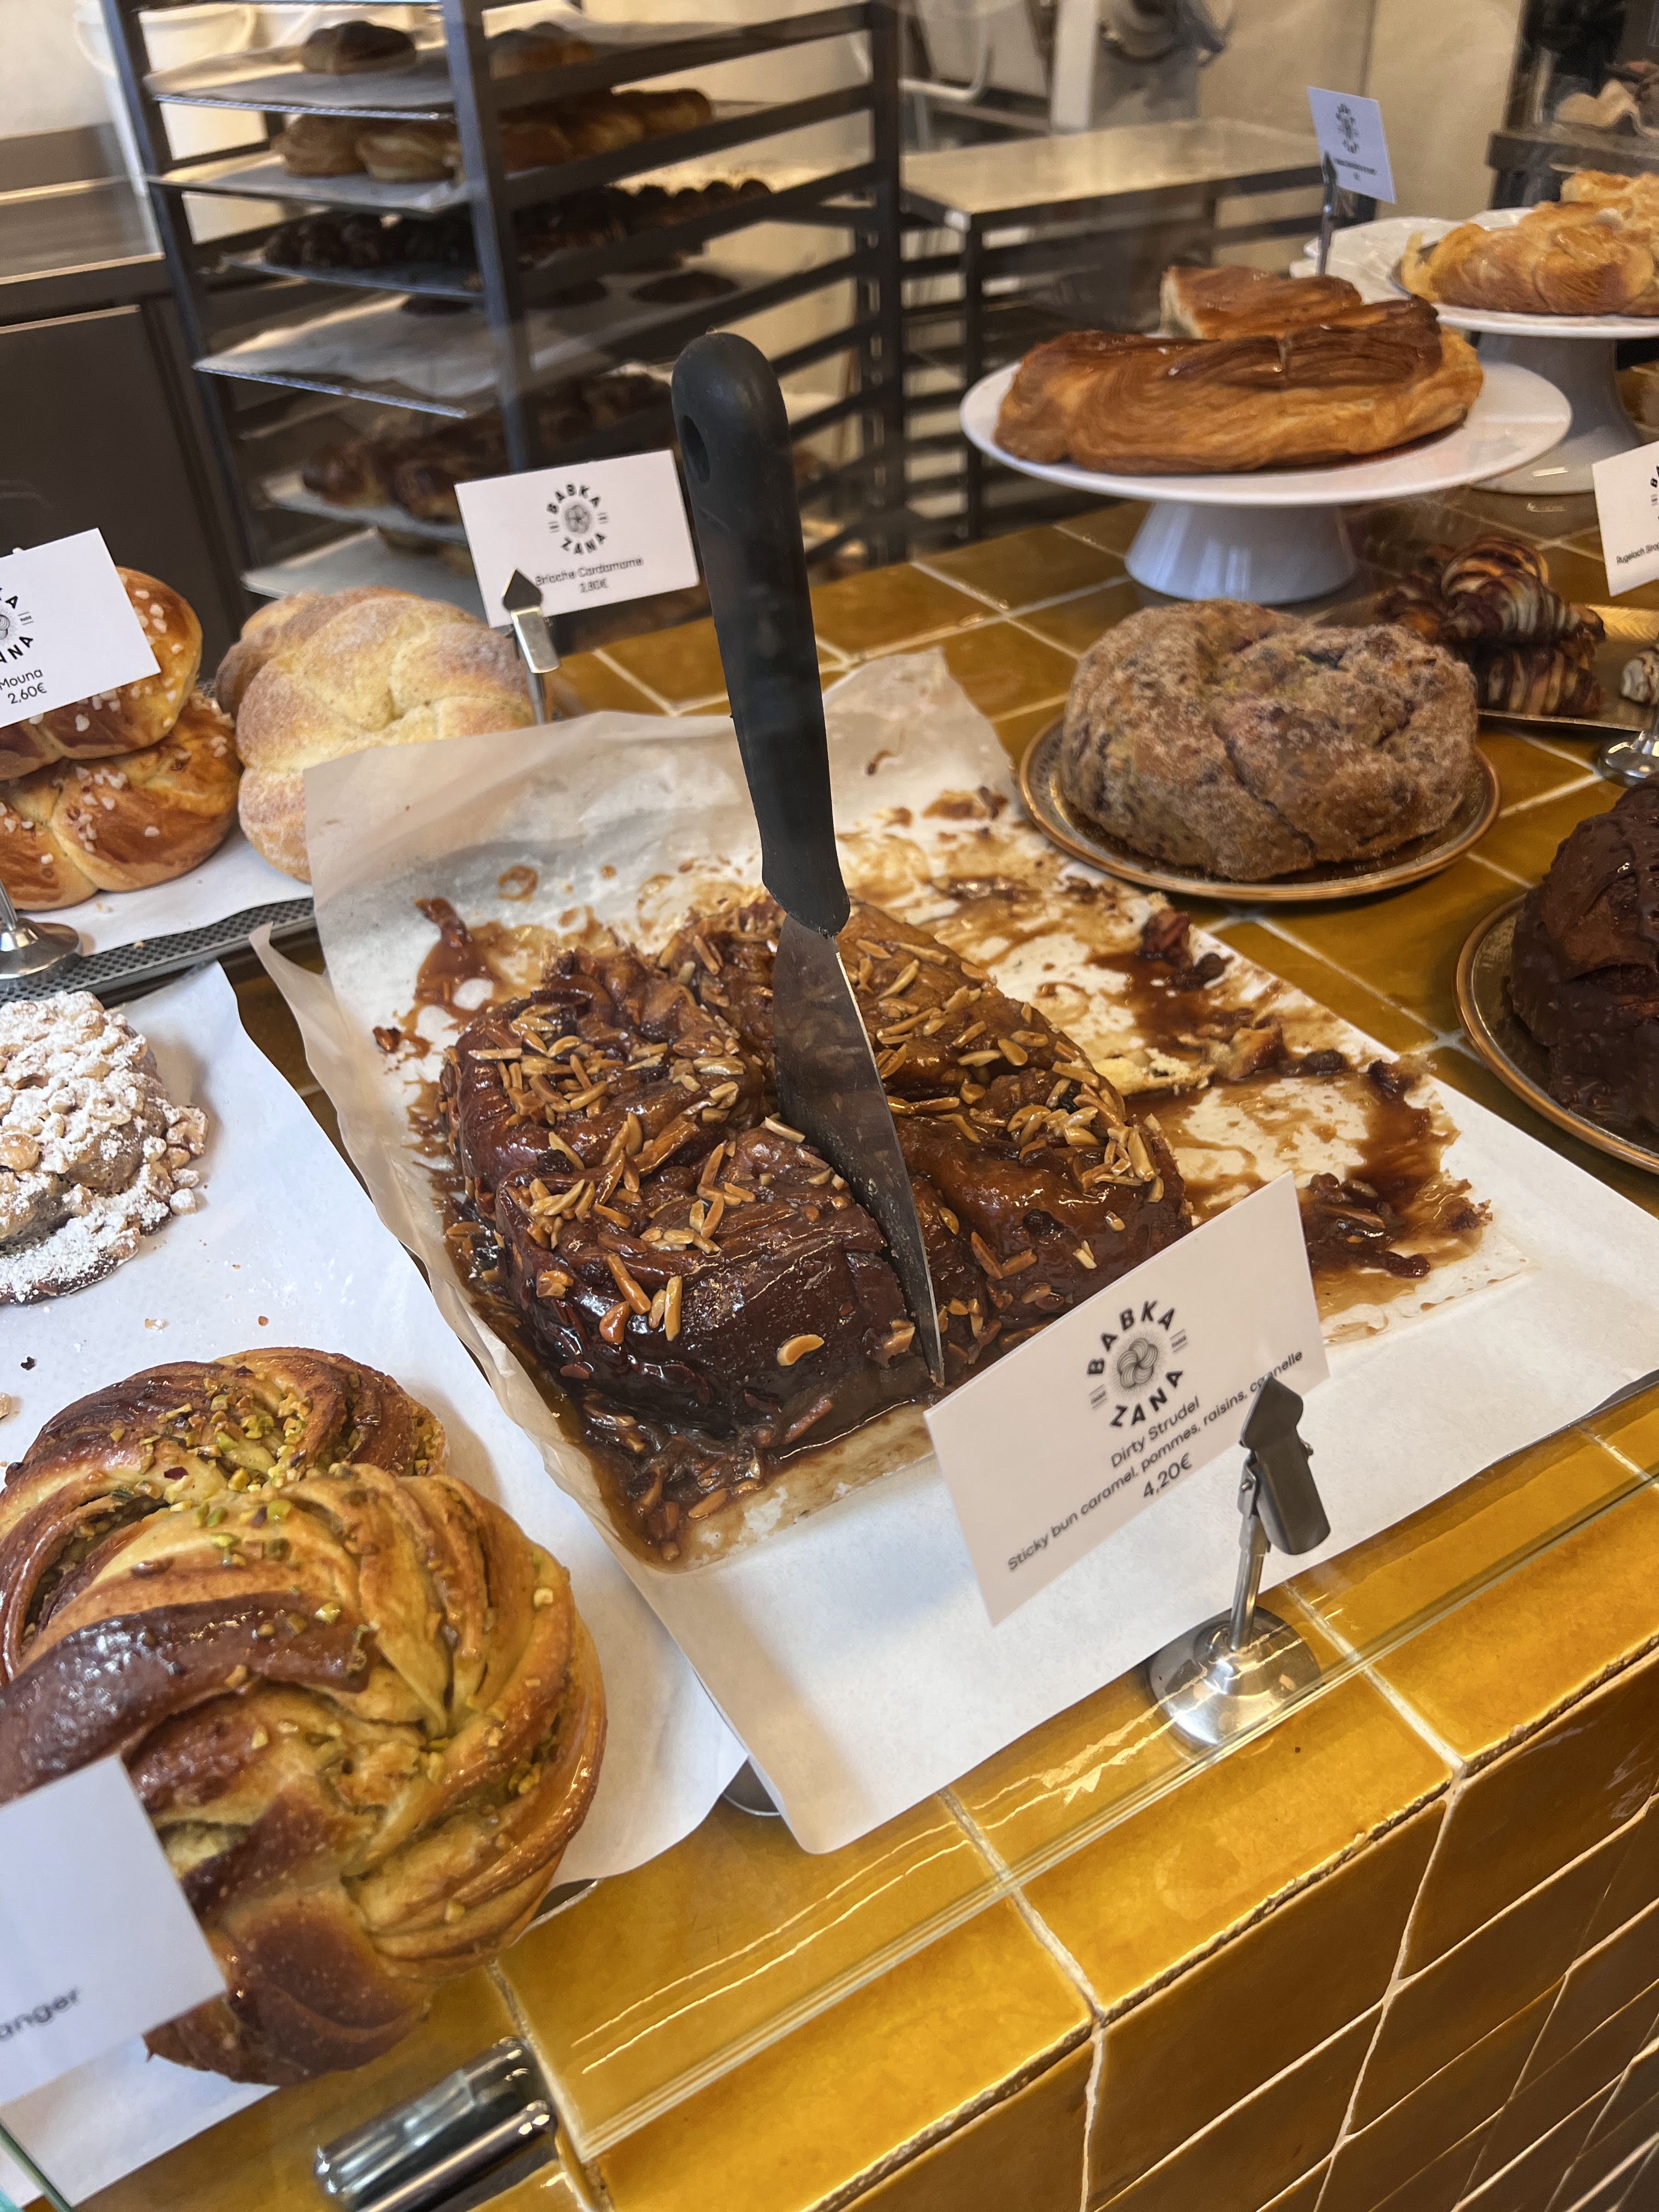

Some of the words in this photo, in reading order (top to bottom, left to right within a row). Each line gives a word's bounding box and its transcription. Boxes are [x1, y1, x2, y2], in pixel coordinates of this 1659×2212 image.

[546, 483, 601, 515] BABKA
[560, 533, 607, 555] ZANA
[0, 669, 43, 690] Mouna
[8, 682, 47, 704] 2,60€
[1087, 1300, 1175, 1374] BABKA
[1109, 1370, 1183, 1427] ZANA
[1111, 1436, 1144, 1468] Dirty
[1148, 1396, 1199, 1441] Strudel
[1008, 1533, 1048, 1571] Sticky
[1051, 1513, 1078, 1537] bun
[1080, 1466, 1138, 1515] caramel,
[1141, 1424, 1200, 1472] pommes,
[1203, 1391, 1248, 1425] raisins,
[1143, 1452, 1192, 1497] 4,20€
